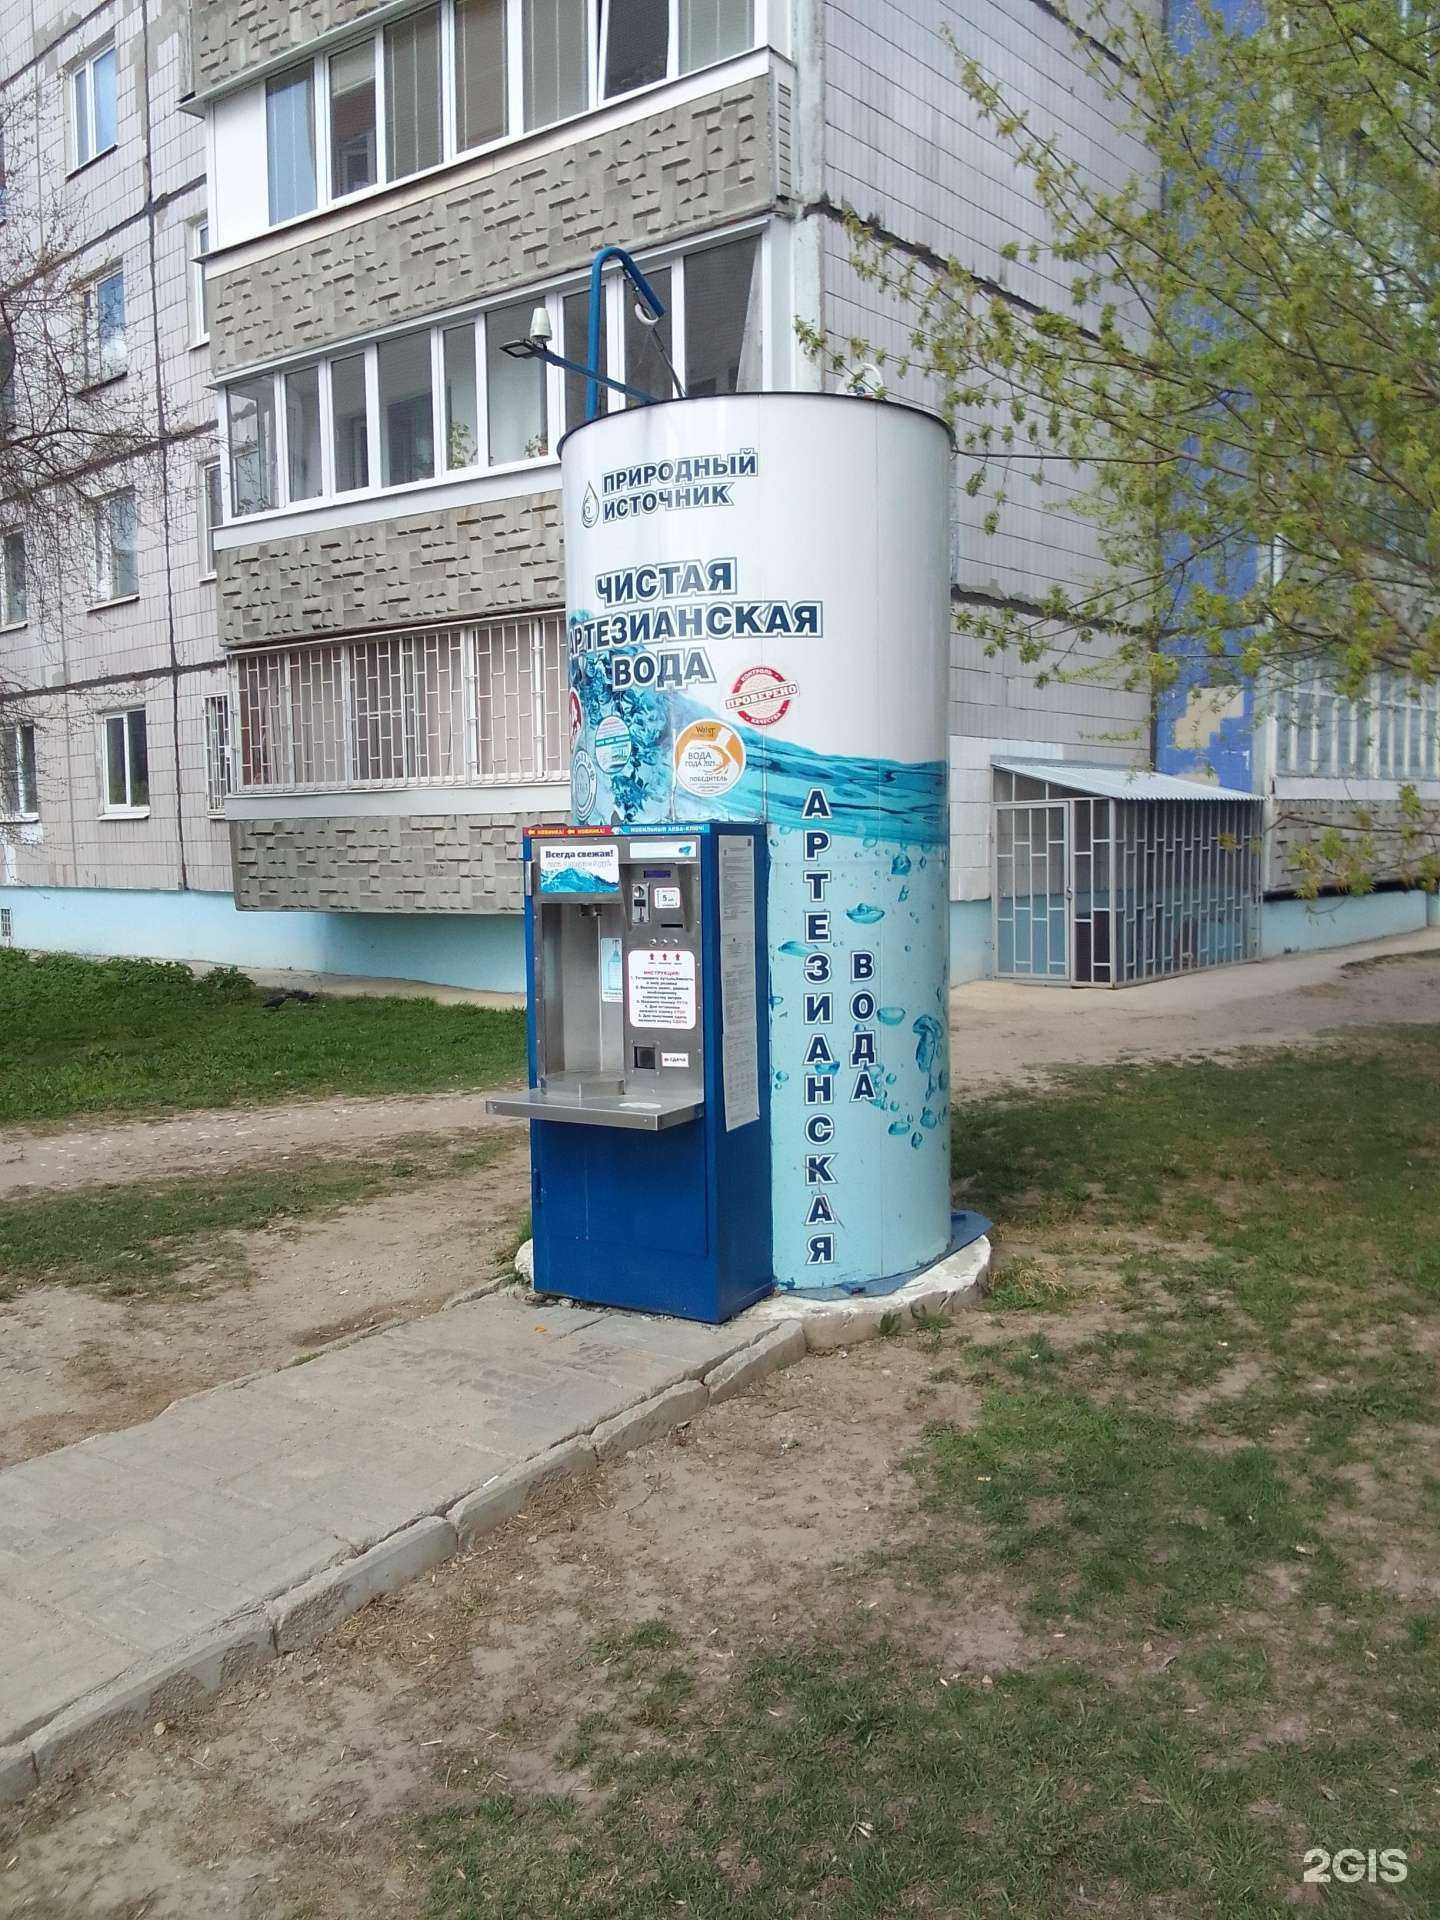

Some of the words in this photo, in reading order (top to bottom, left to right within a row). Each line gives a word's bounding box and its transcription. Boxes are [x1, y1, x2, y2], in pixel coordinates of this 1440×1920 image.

[603, 450, 756, 494] ПРИРОДНЫЙ
[603, 484, 731, 521] ИСТОЧНИК
[596, 562, 733, 604] ЧИСТАЯ
[614, 651, 710, 687] ВОДА
[726, 683, 798, 709] ПРОВЕРЕНО
[688, 751, 712, 761] ВОДА
[545, 850, 576, 859] Всегда
[577, 850, 614, 858] свежая!
[804, 788, 836, 1264] АРТЕЗИАНСКАЯ
[850, 952, 877, 1101] ВОДА
